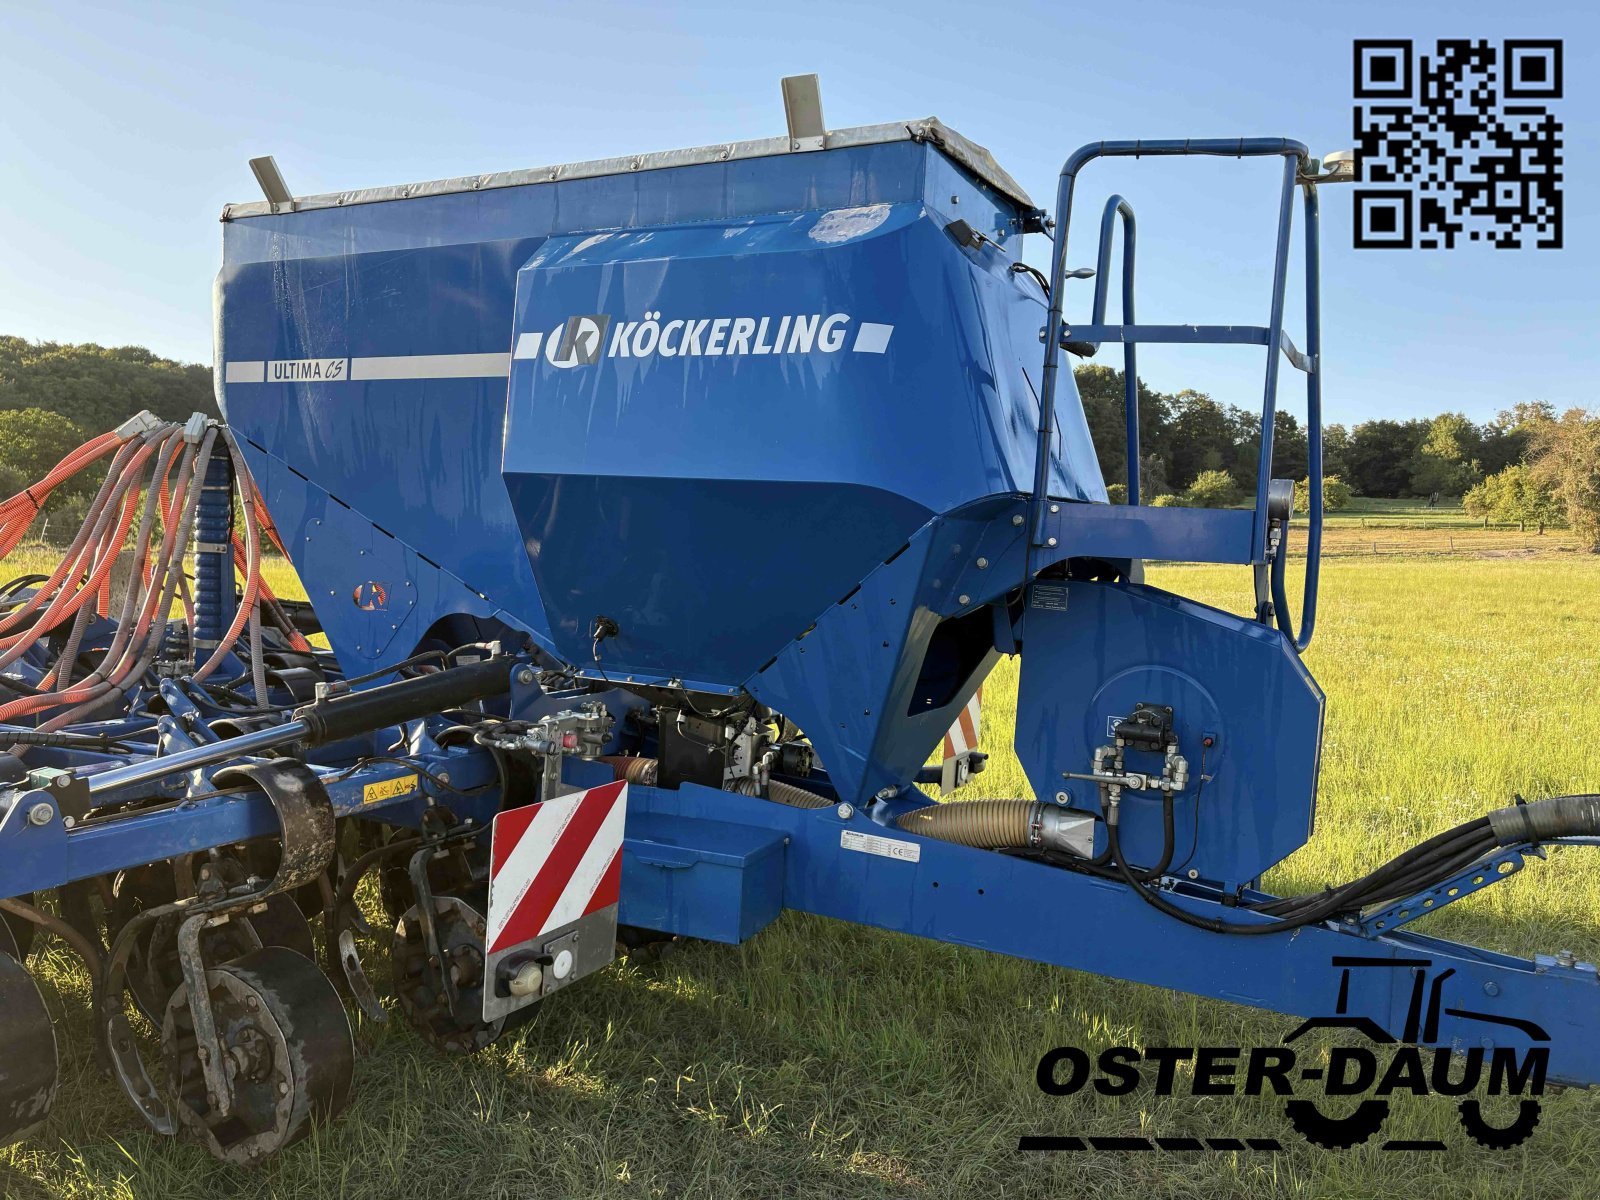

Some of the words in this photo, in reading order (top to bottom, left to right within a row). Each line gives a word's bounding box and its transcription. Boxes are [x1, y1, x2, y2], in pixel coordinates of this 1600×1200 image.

[608, 311, 850, 358] KÖCKERLING
[274, 362, 321, 379] ULTIMA
[325, 360, 344, 378] CS
[893, 847, 904, 856] CE
